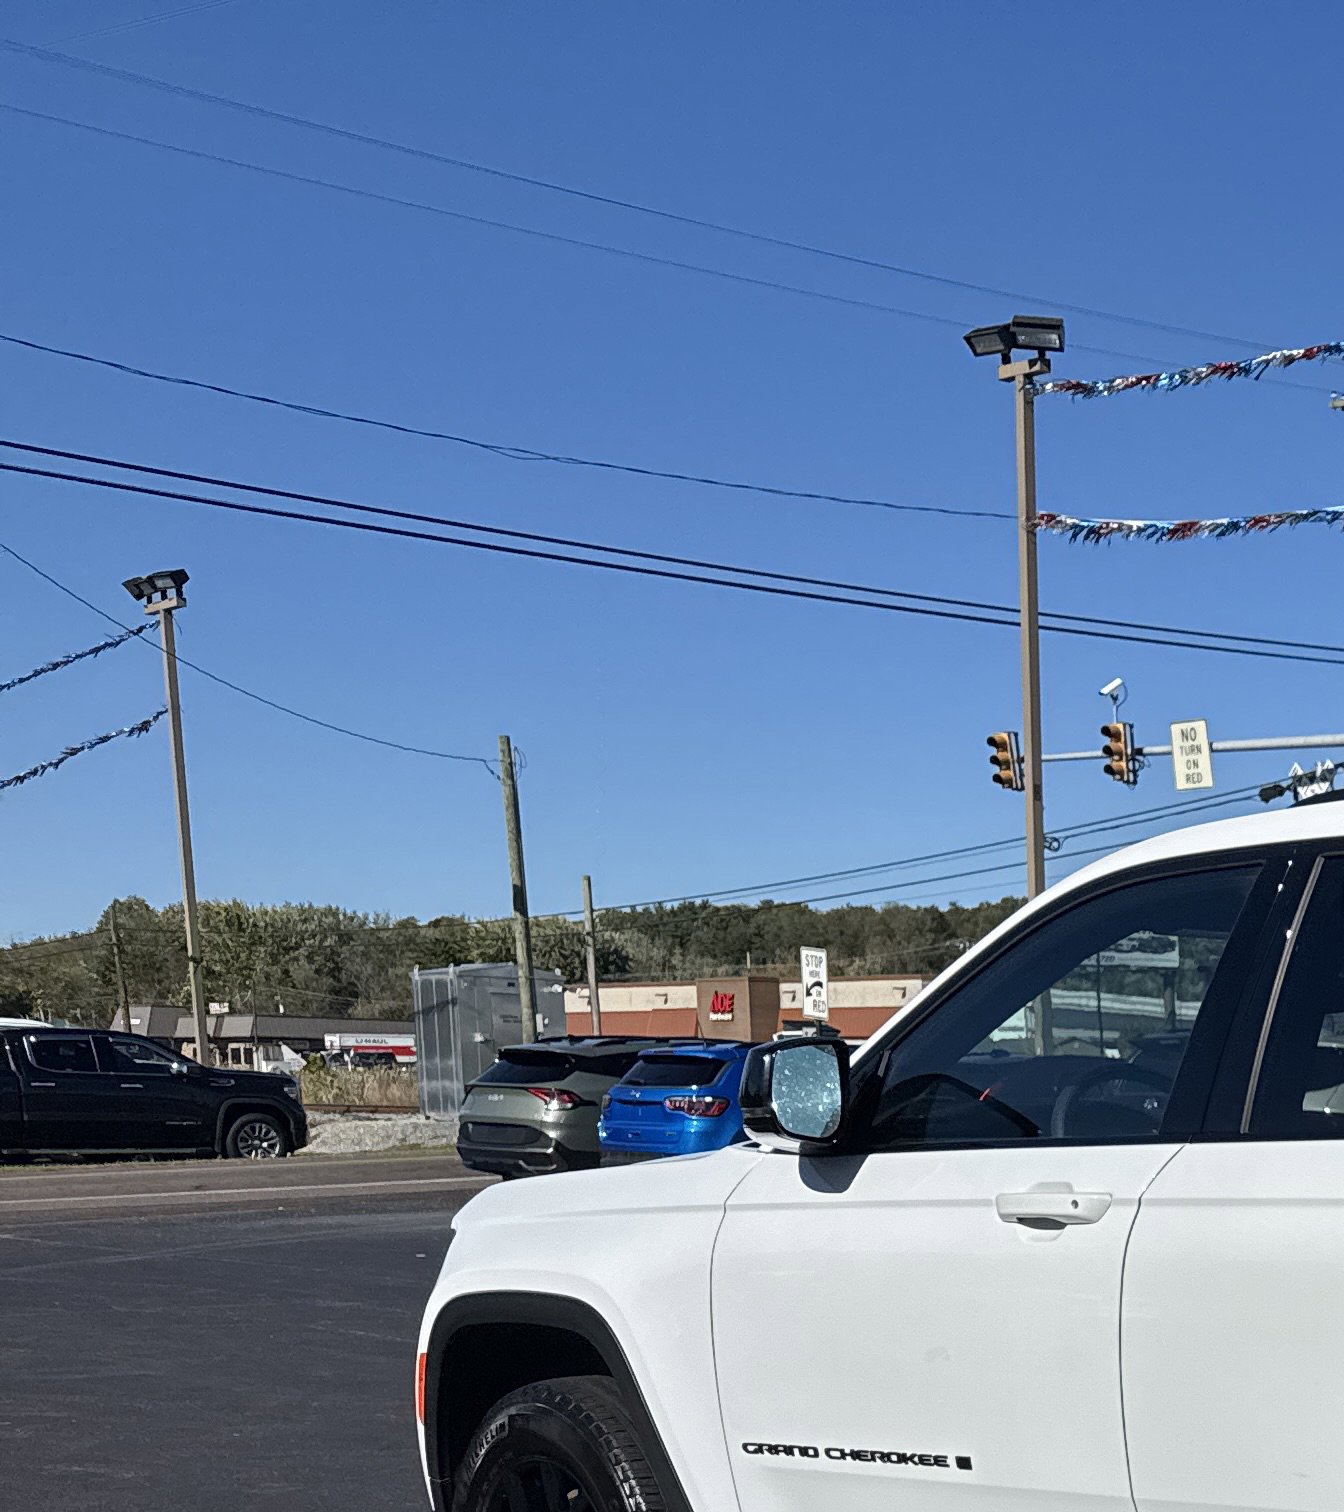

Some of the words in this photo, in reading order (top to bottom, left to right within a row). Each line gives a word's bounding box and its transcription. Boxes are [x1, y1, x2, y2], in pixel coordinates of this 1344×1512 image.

[1181, 727, 1197, 742] NO
[1180, 744, 1202, 756] TURN
[1186, 759, 1199, 770] ON
[1186, 773, 1203, 784] RED
[805, 954, 824, 968] STOP
[813, 1000, 826, 1013] RED
[741, 1442, 820, 1459] GRAND
[824, 1447, 951, 1468] CHEROKEE
